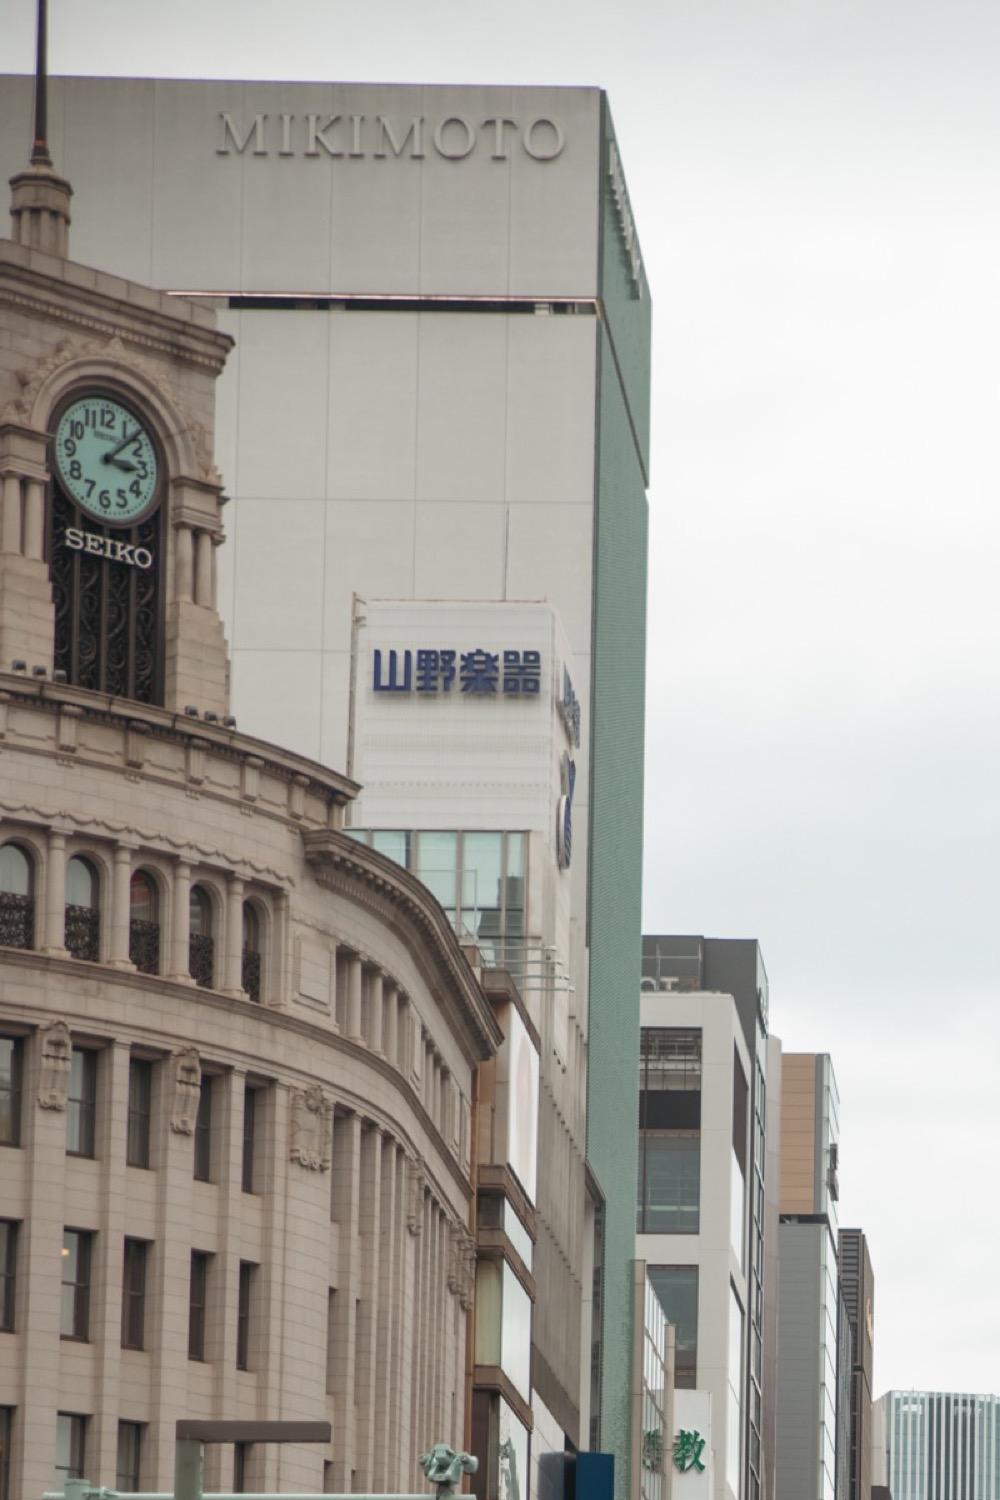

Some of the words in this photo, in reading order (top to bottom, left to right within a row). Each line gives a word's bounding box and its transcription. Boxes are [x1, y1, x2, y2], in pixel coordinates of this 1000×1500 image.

[216, 113, 566, 162] MIKIMOTO
[70, 419, 84, 440] 10
[101, 408, 116, 430] 12
[64, 438, 77, 458] 9
[69, 459, 82, 481] 8
[136, 460, 148, 480] 3
[84, 478, 97, 498] 7
[115, 488, 128, 509] 5
[129, 479, 142, 498] 4
[99, 489, 112, 509] 6
[65, 527, 152, 568] SEIKO
[373, 649, 541, 693] 山野楽器
